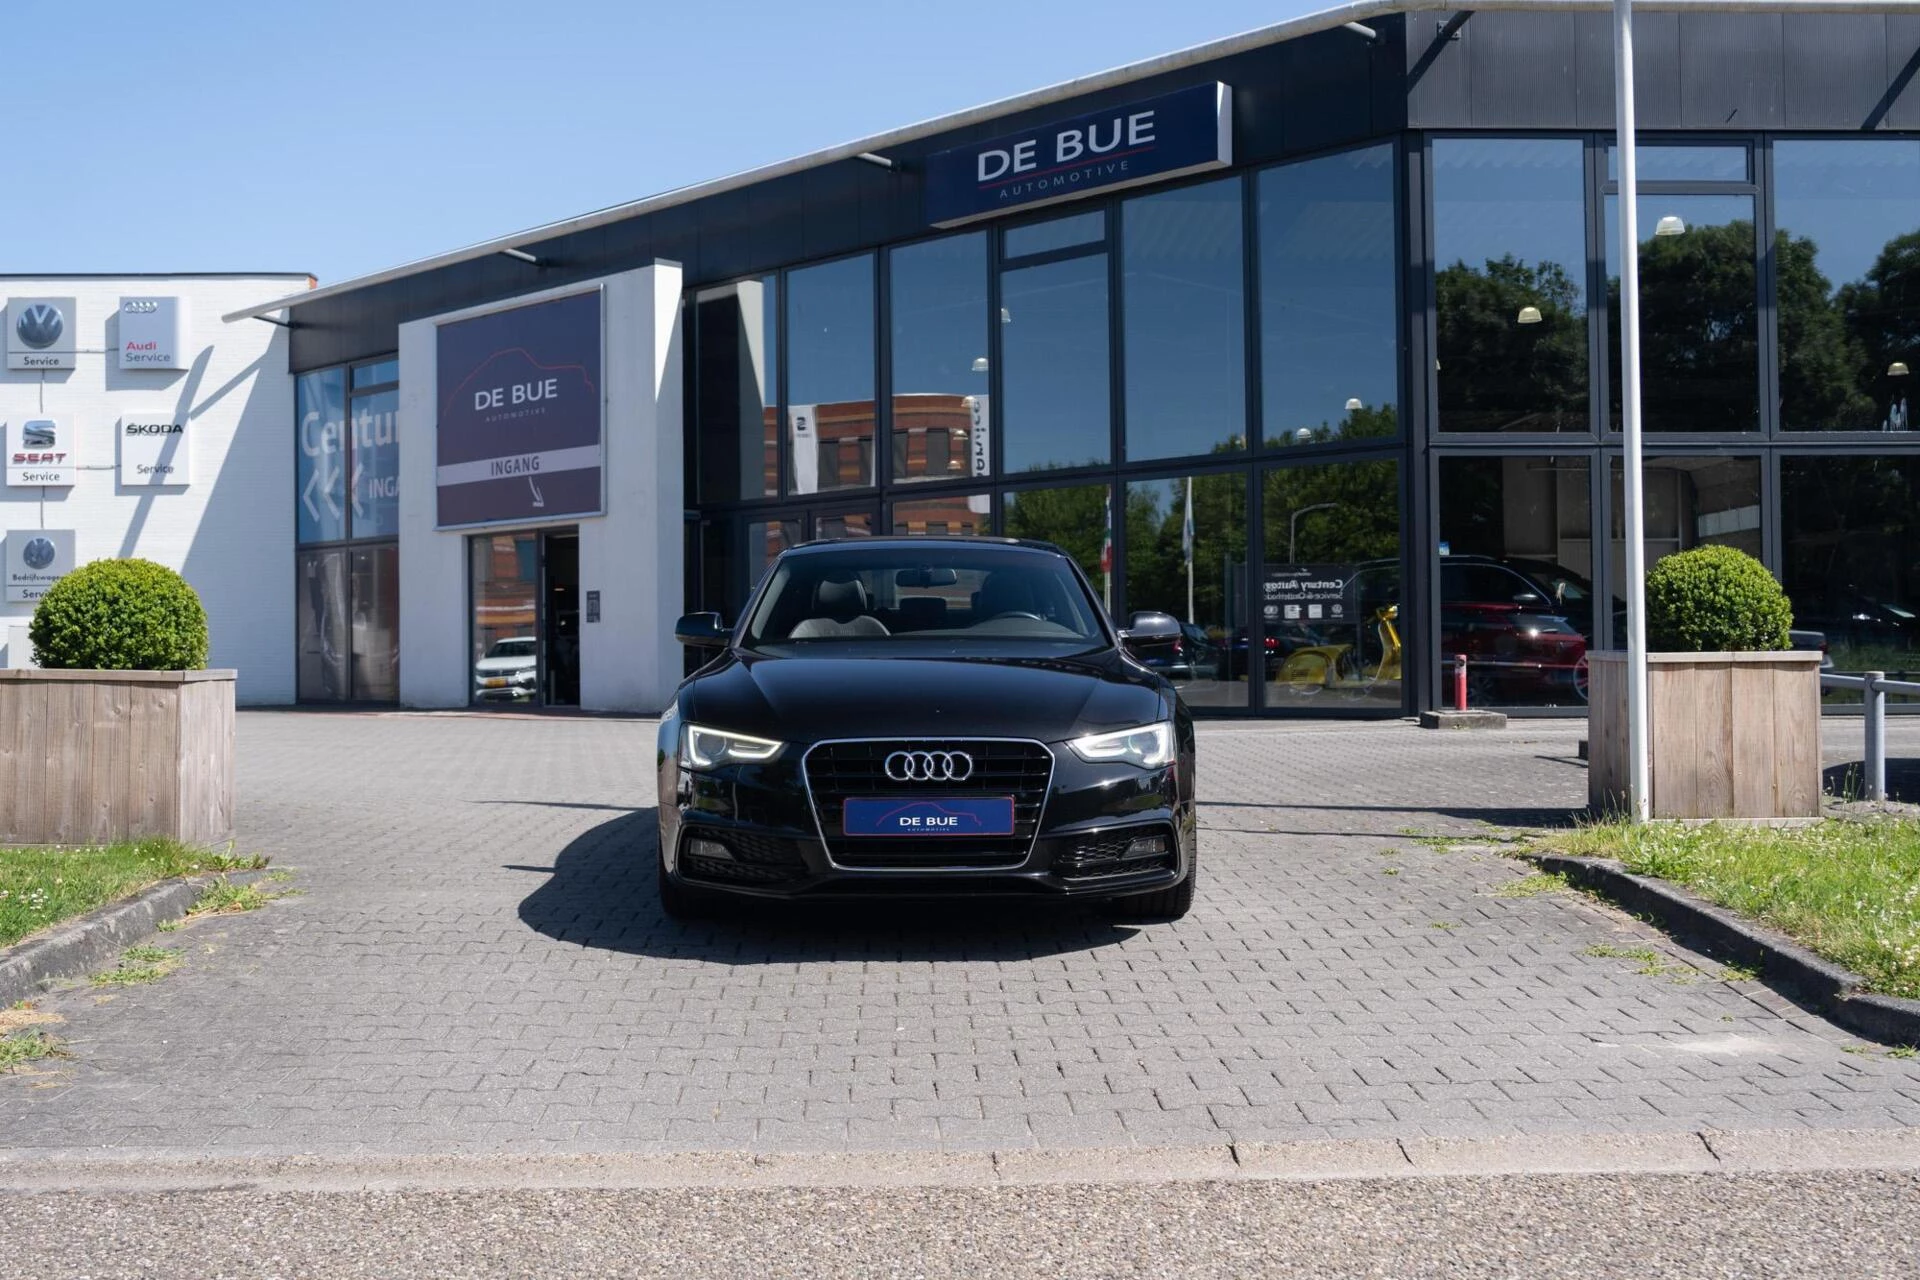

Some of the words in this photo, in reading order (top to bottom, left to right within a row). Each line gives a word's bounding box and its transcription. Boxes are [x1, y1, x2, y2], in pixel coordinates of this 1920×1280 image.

[978, 139, 1037, 182] DE
[1056, 110, 1156, 163] BUE
[1000, 160, 1129, 199] AUTOMOTIVE
[126, 341, 157, 351] Audi
[23, 356, 60, 366] Service
[125, 352, 171, 362] Service
[475, 388, 504, 411] DE
[512, 378, 558, 404] BUE
[126, 422, 184, 435] ŠKODA
[12, 453, 67, 464] SEAT
[136, 464, 174, 475] Service
[491, 455, 540, 476] INGANG
[22, 471, 61, 481] Service
[899, 817, 921, 826] DE
[926, 817, 958, 826] BUE
